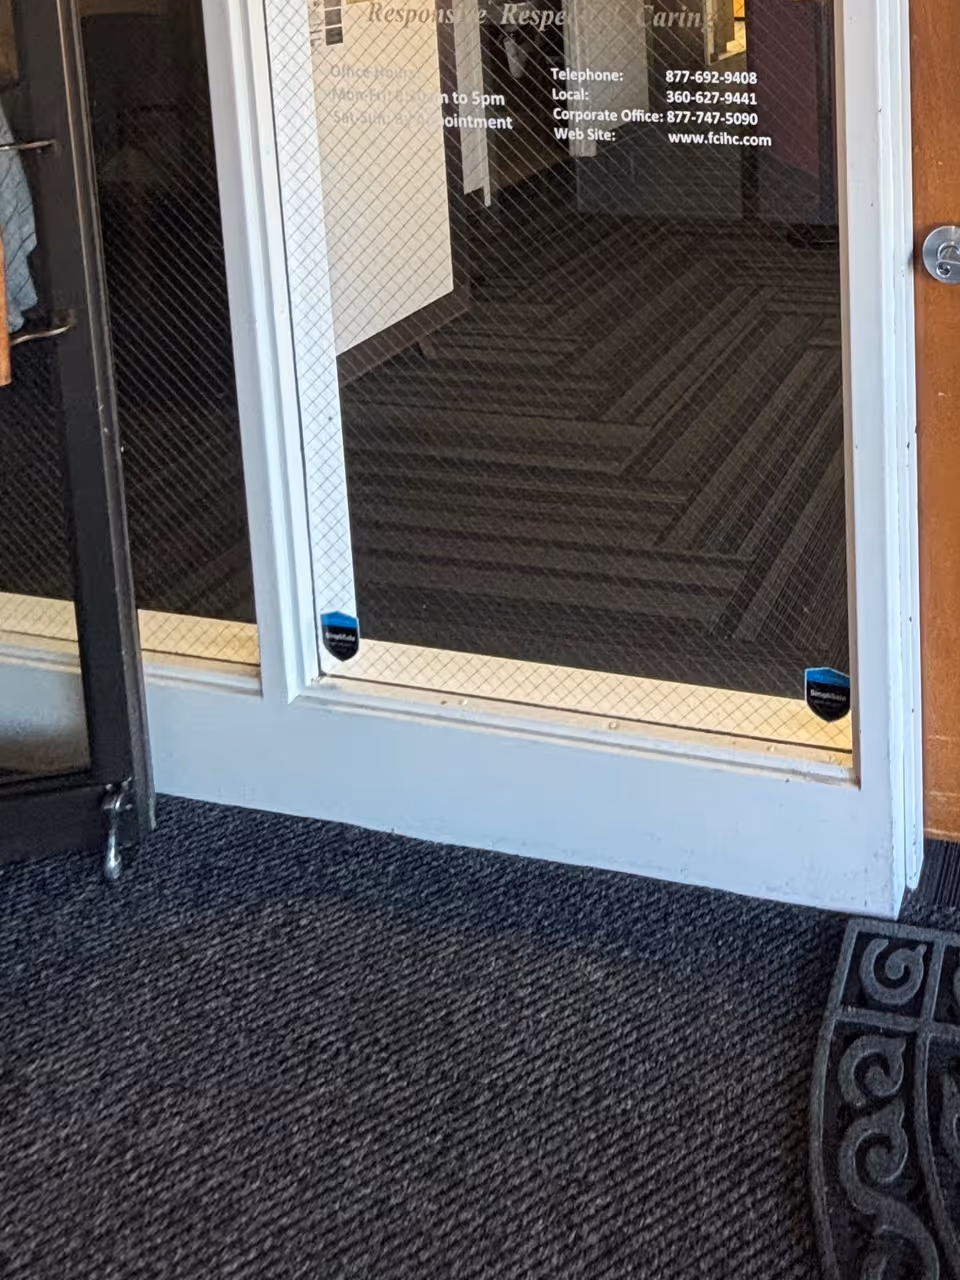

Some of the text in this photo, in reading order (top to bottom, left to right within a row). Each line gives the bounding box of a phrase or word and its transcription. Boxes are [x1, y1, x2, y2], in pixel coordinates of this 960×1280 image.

[369, 2, 486, 28] Response
[551, 68, 757, 85] Telephone: 877-692-9408
[452, 92, 467, 104] to
[472, 92, 505, 107] 5pm
[552, 88, 757, 105] Local: 360-627-9441
[553, 108, 758, 126] Corporate Office: 877-747-5090
[554, 128, 772, 147] Web Site: www.fcihc.com
